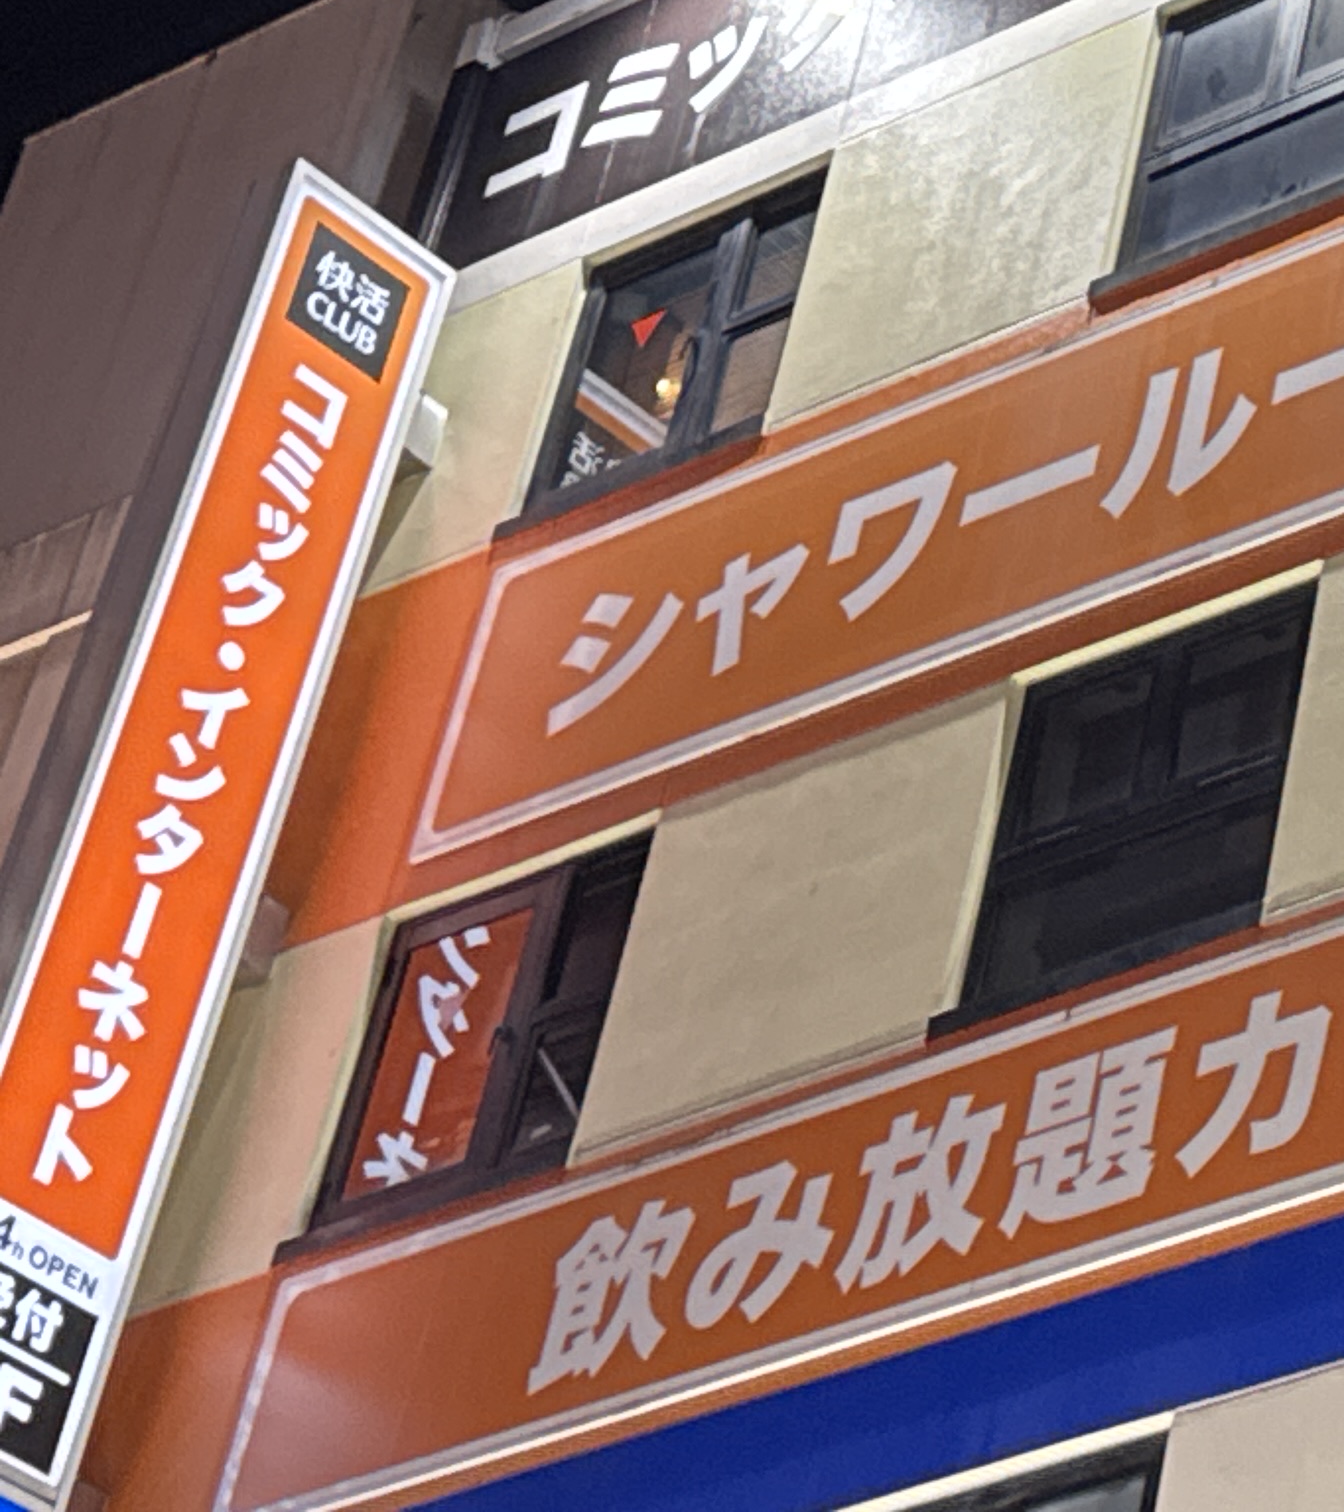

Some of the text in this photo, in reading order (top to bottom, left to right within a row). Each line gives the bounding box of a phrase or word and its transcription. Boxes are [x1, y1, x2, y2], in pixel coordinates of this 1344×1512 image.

[315, 250, 391, 326] 快活
[306, 291, 378, 355] CLUB
[28, 1245, 99, 1300] OPEN
